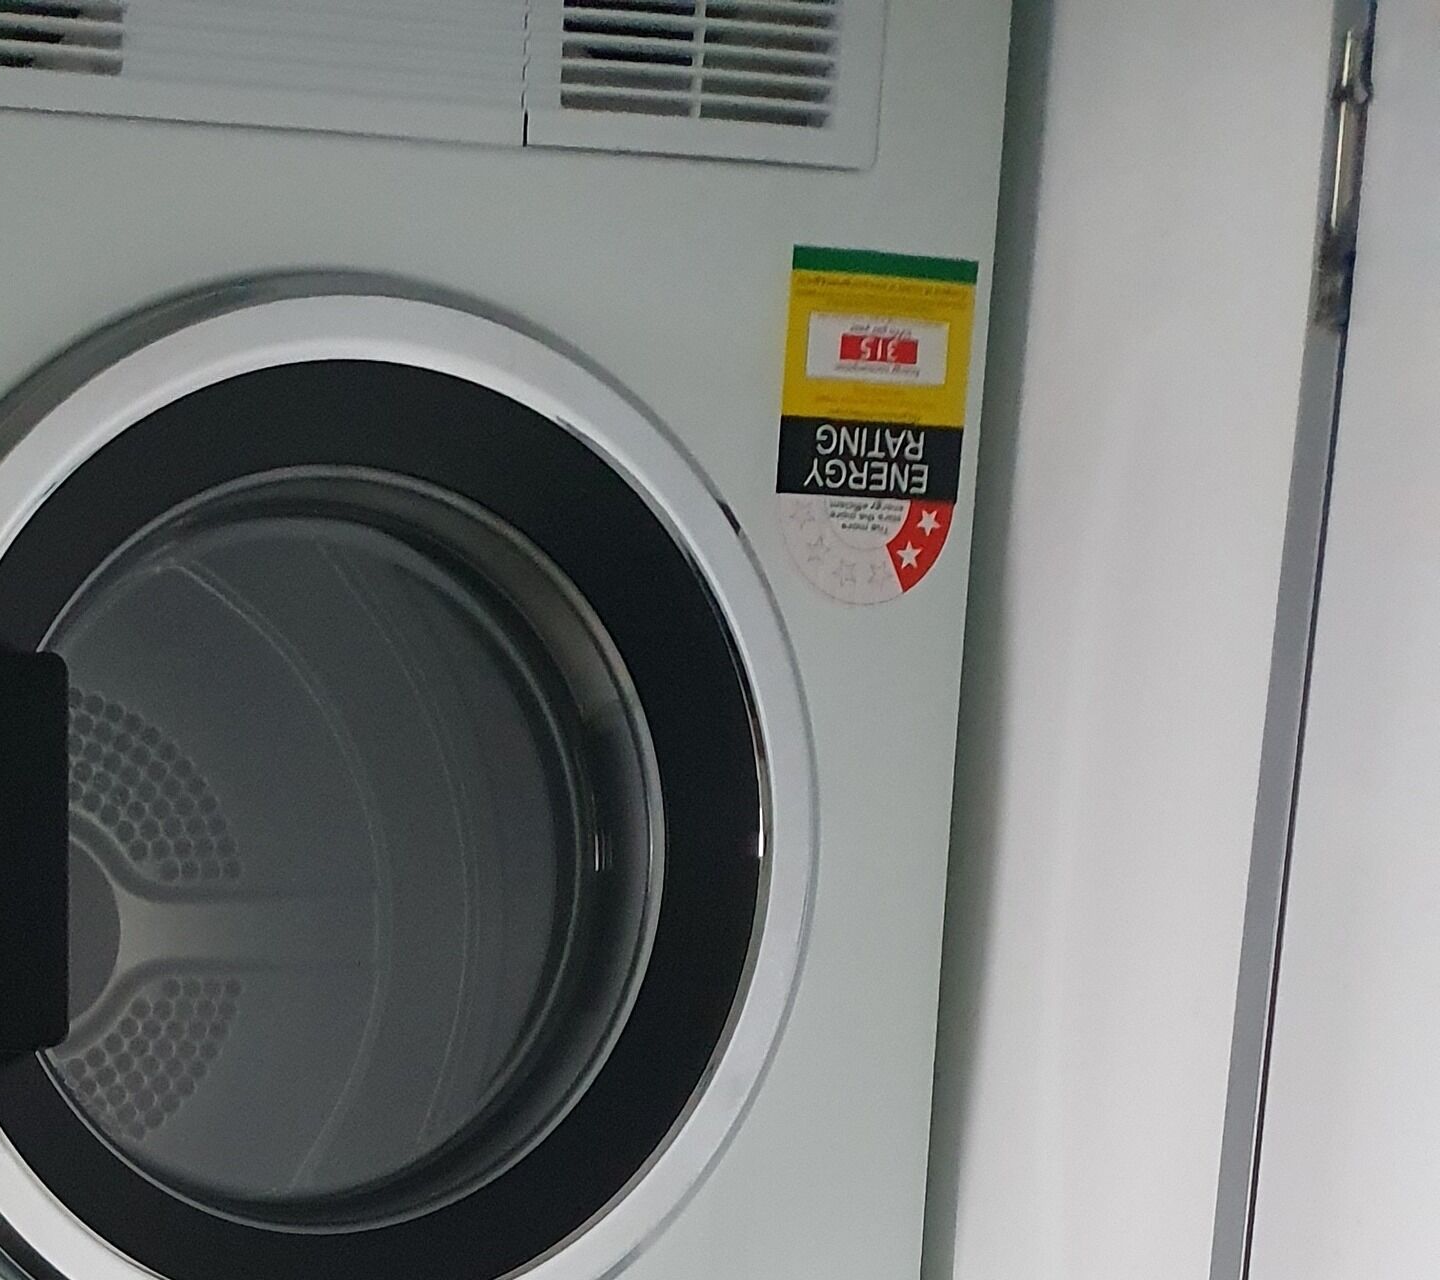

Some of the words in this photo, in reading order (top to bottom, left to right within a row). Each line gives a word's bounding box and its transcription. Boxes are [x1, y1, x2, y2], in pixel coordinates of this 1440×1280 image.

[860, 337, 898, 361] 315
[815, 424, 926, 462] RATING
[803, 458, 930, 494] ENERGY
